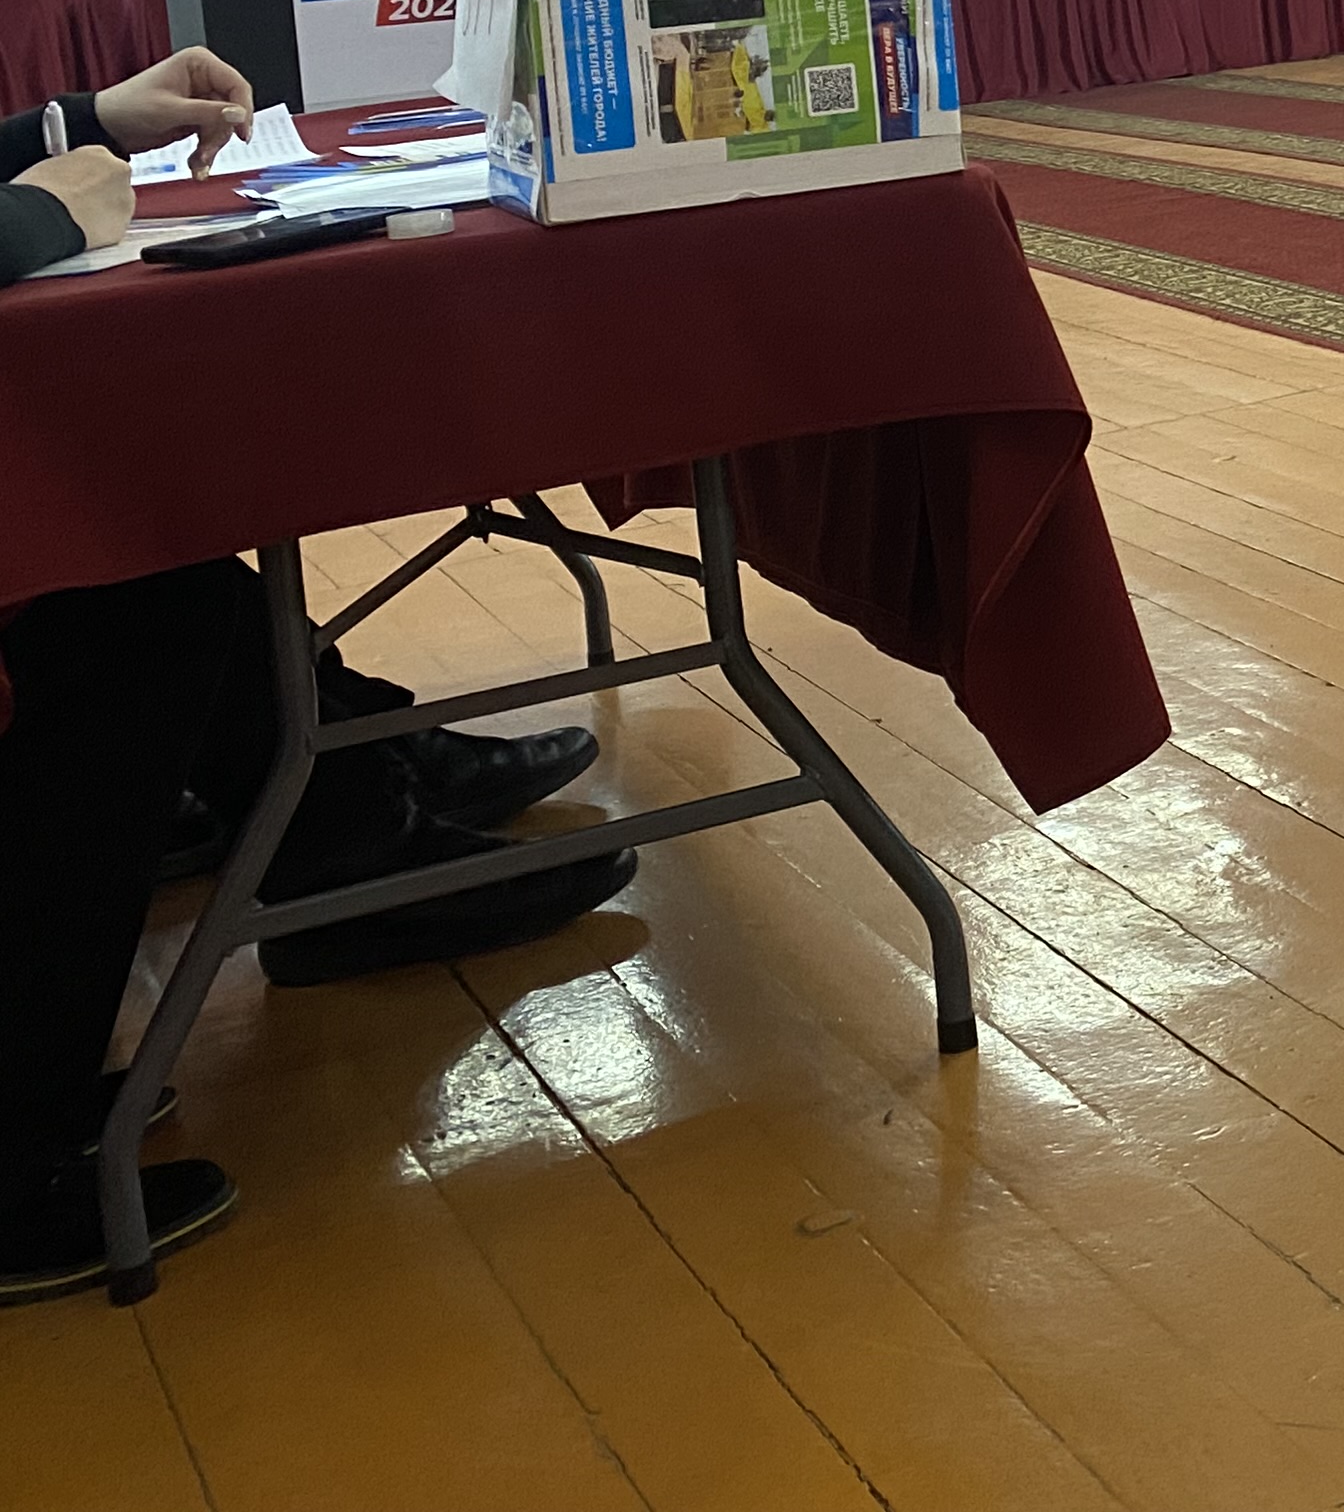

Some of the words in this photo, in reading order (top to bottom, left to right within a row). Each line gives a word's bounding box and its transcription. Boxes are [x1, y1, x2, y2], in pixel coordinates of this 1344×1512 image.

[586, 24, 603, 84] ЖИТЕЛЕЙ
[604, 40, 618, 96] БЮДЖЕТ
[592, 88, 607, 142] ГОРОДА!
